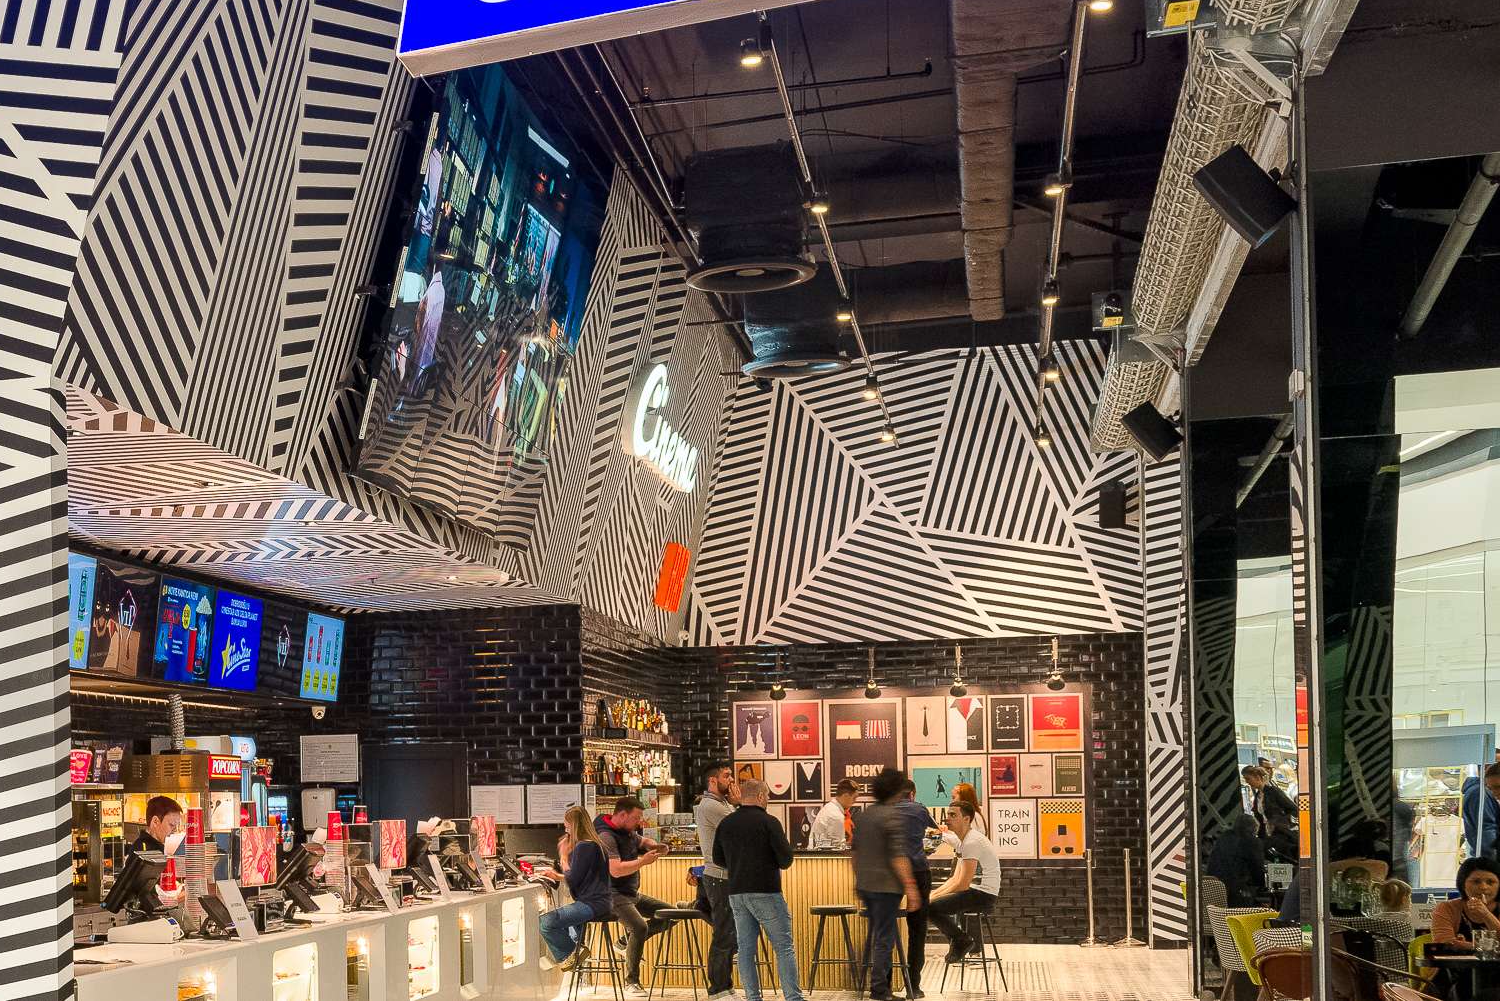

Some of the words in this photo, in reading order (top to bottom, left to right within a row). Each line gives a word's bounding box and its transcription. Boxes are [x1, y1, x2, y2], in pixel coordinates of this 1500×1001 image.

[212, 761, 241, 775] POPCORN
[845, 764, 884, 777] ROCKY
[997, 809, 1030, 820] TRAIN
[998, 823, 1030, 833] SPOTT
[999, 837, 1019, 847] ING
